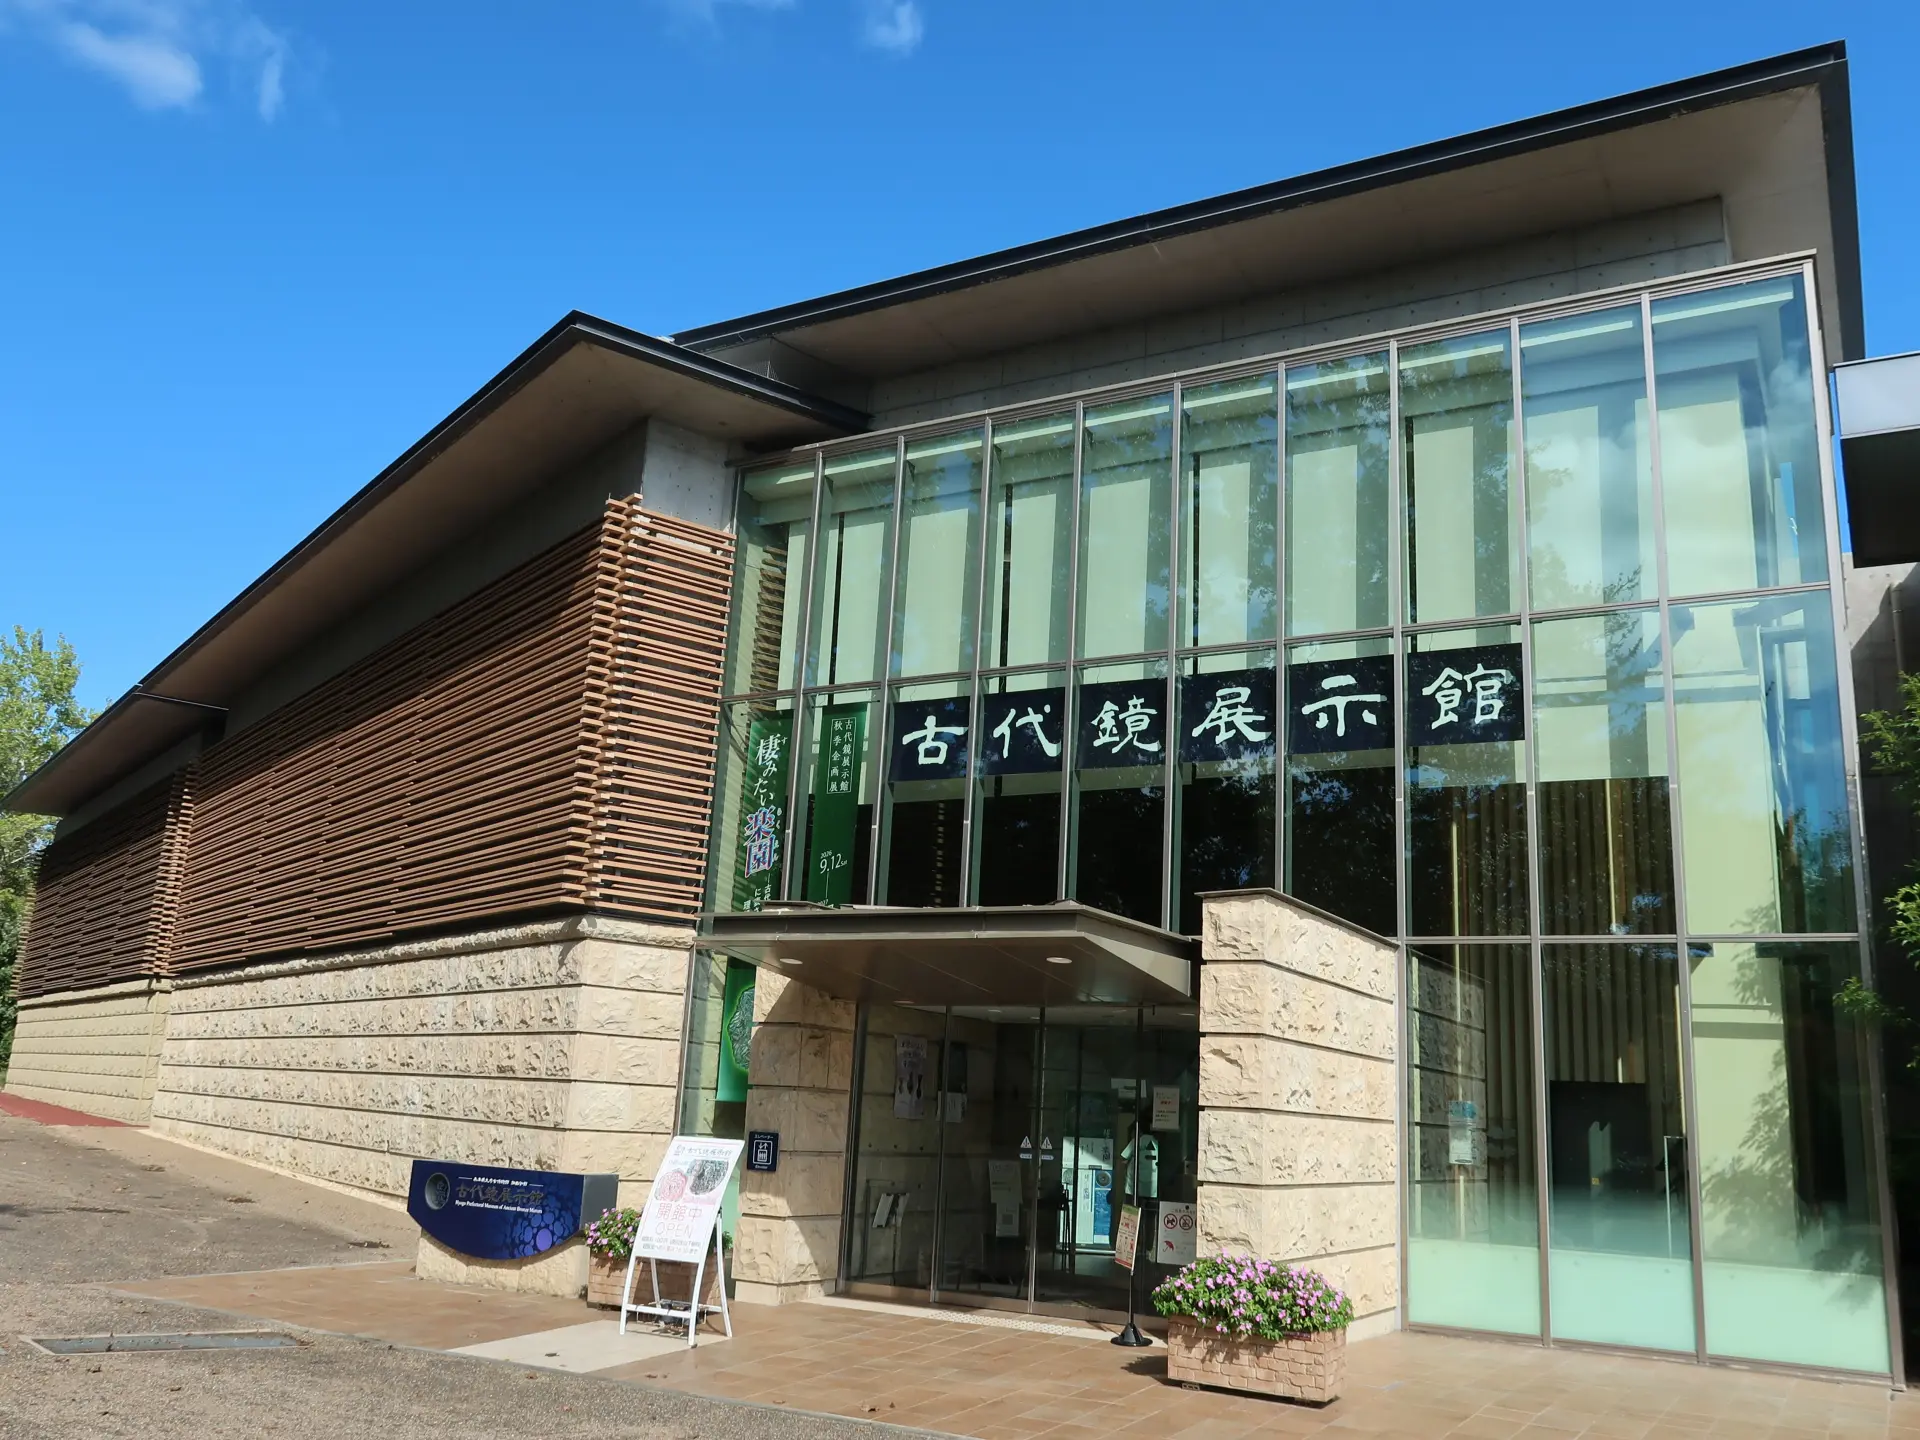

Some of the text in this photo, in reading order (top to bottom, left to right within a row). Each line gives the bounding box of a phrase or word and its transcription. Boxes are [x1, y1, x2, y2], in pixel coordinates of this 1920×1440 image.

[902, 662, 1514, 765] 古代鏡展示館
[829, 720, 843, 792] 秋季企画展
[840, 719, 853, 791] 古代鏡展示館
[655, 1222, 694, 1239] OPEN
